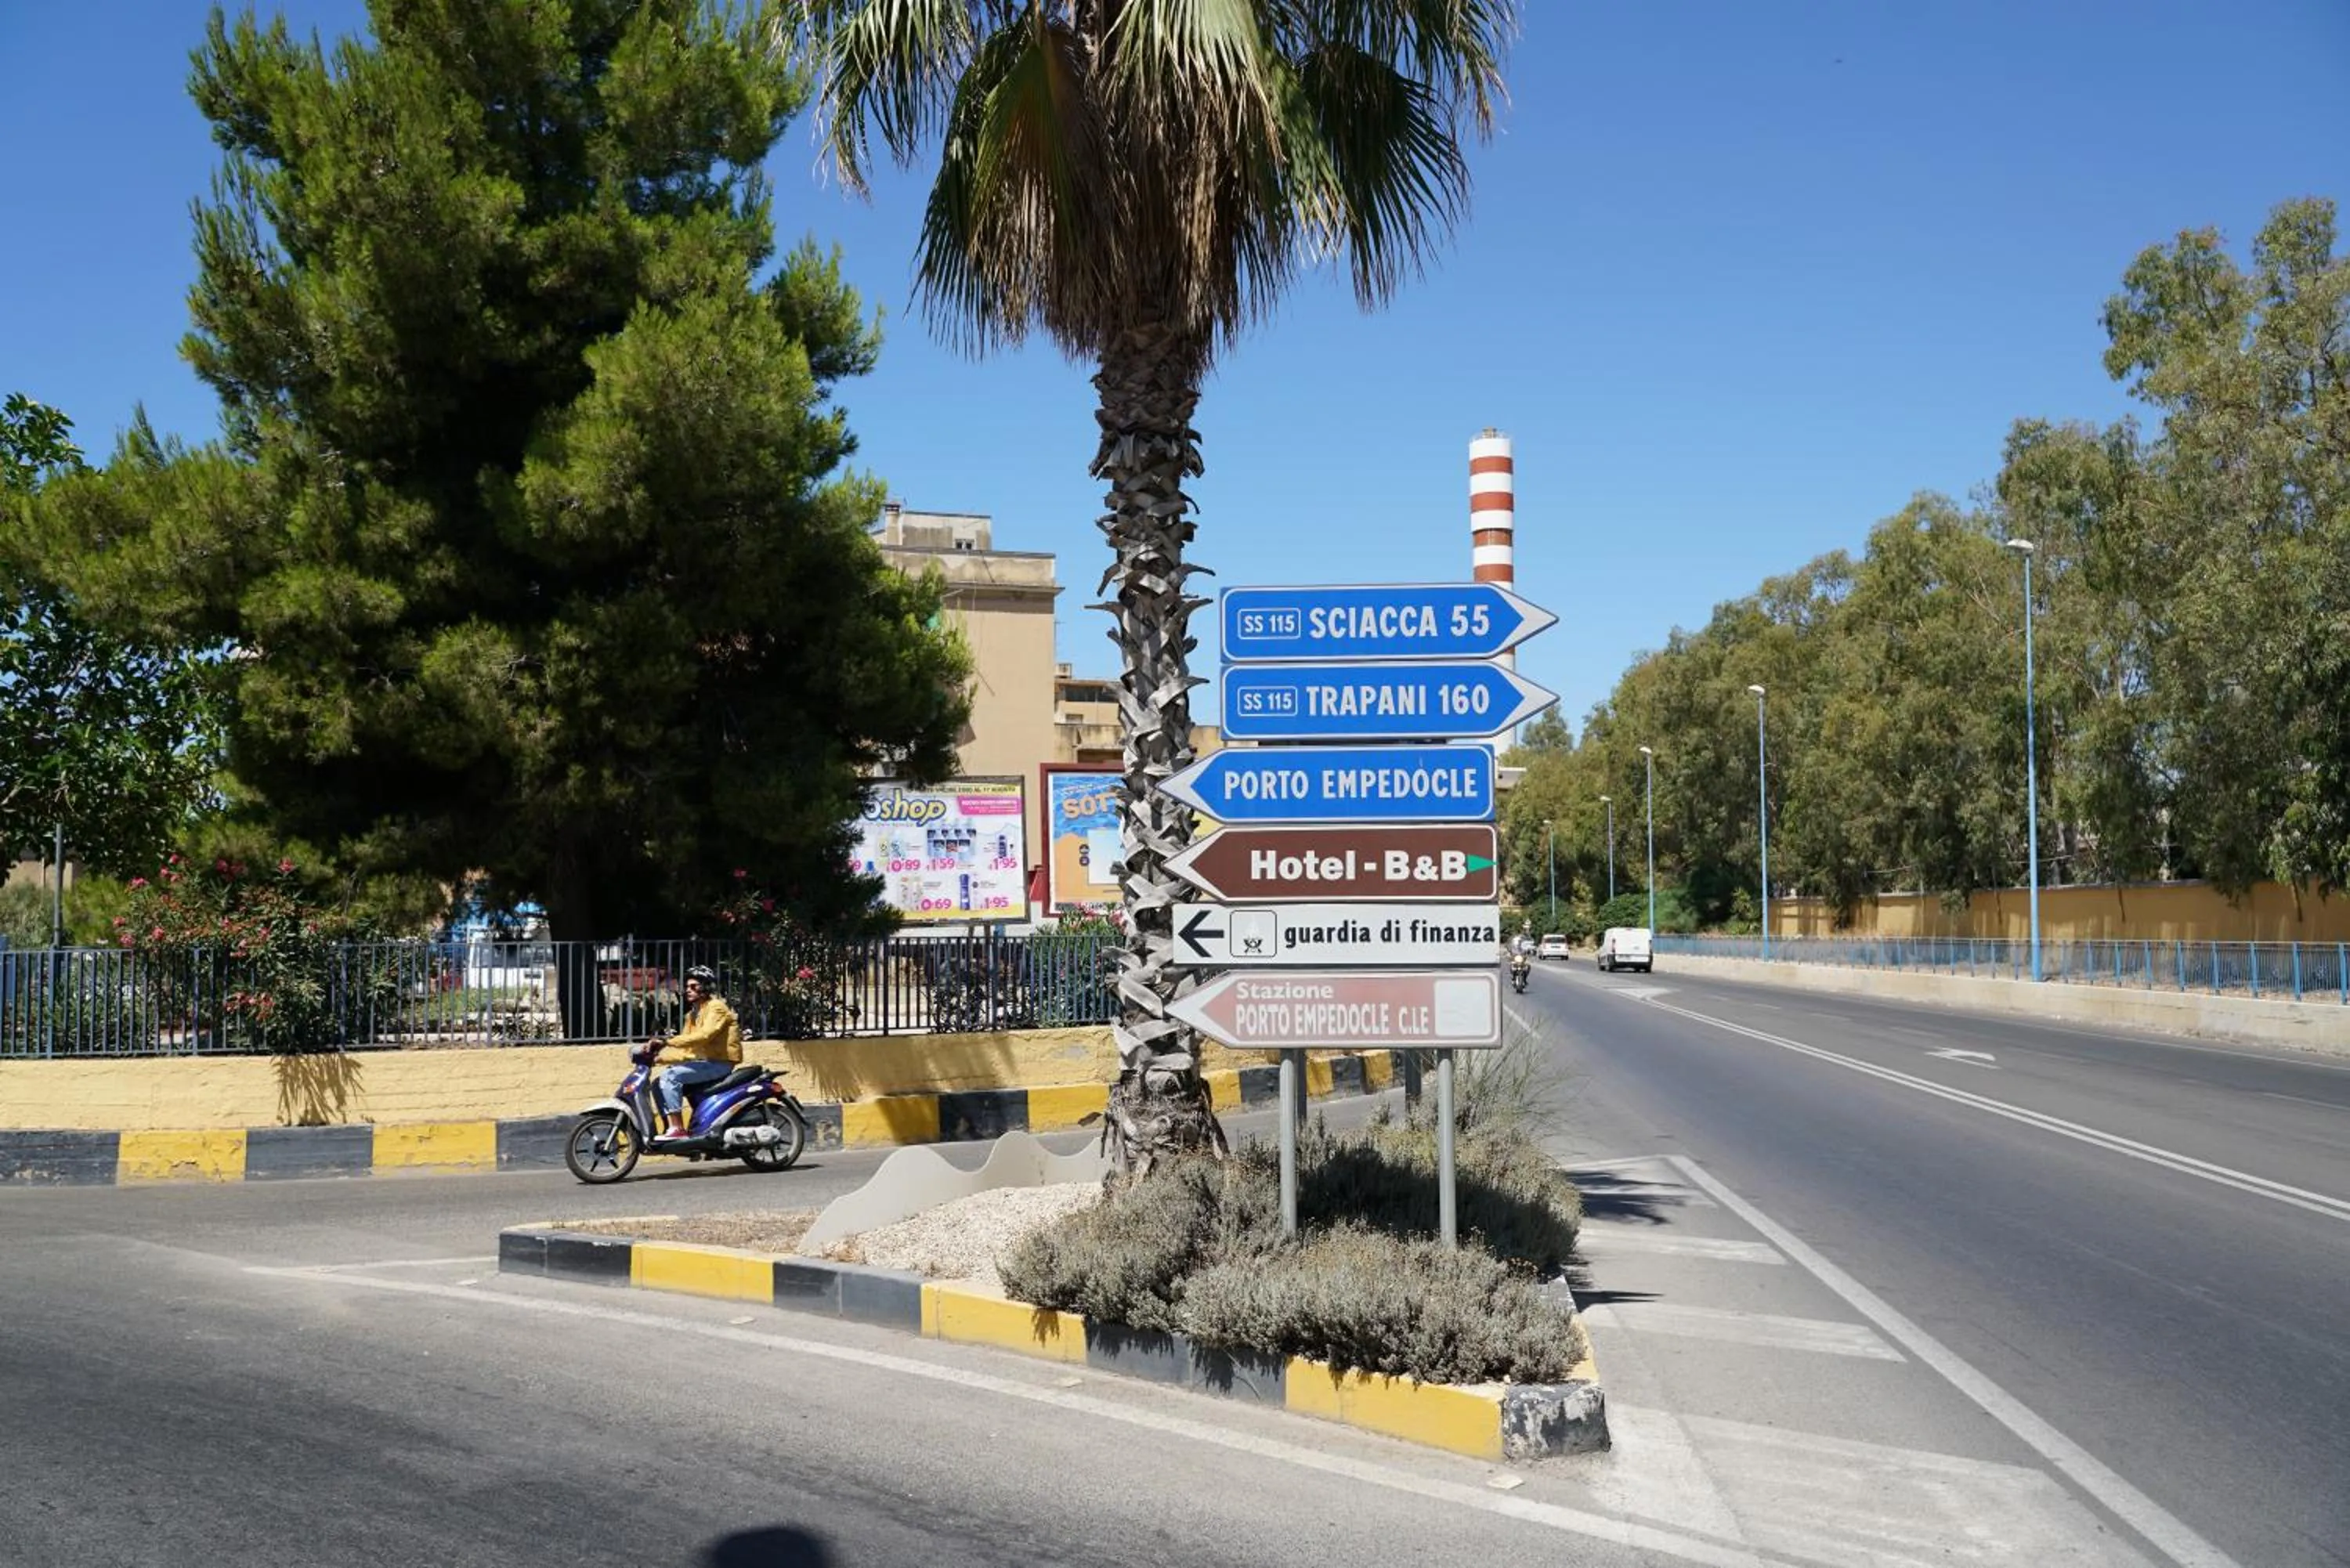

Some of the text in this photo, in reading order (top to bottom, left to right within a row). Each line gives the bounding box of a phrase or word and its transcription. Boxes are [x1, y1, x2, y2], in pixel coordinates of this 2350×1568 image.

[1243, 605, 1490, 638] SS 115 SCIACCA 55
[1243, 684, 1489, 716] SS 115 TRAPANI 160
[1224, 768, 1478, 800] PORTO EMPEDOCLE
[1251, 851, 1355, 880] Hotel
[1384, 851, 1467, 881] B&B
[1285, 919, 1495, 948] guardia di finanza
[1236, 981, 1333, 999] Stazione
[1235, 1003, 1429, 1035] PORTO EMPEDOCLE C.LE
